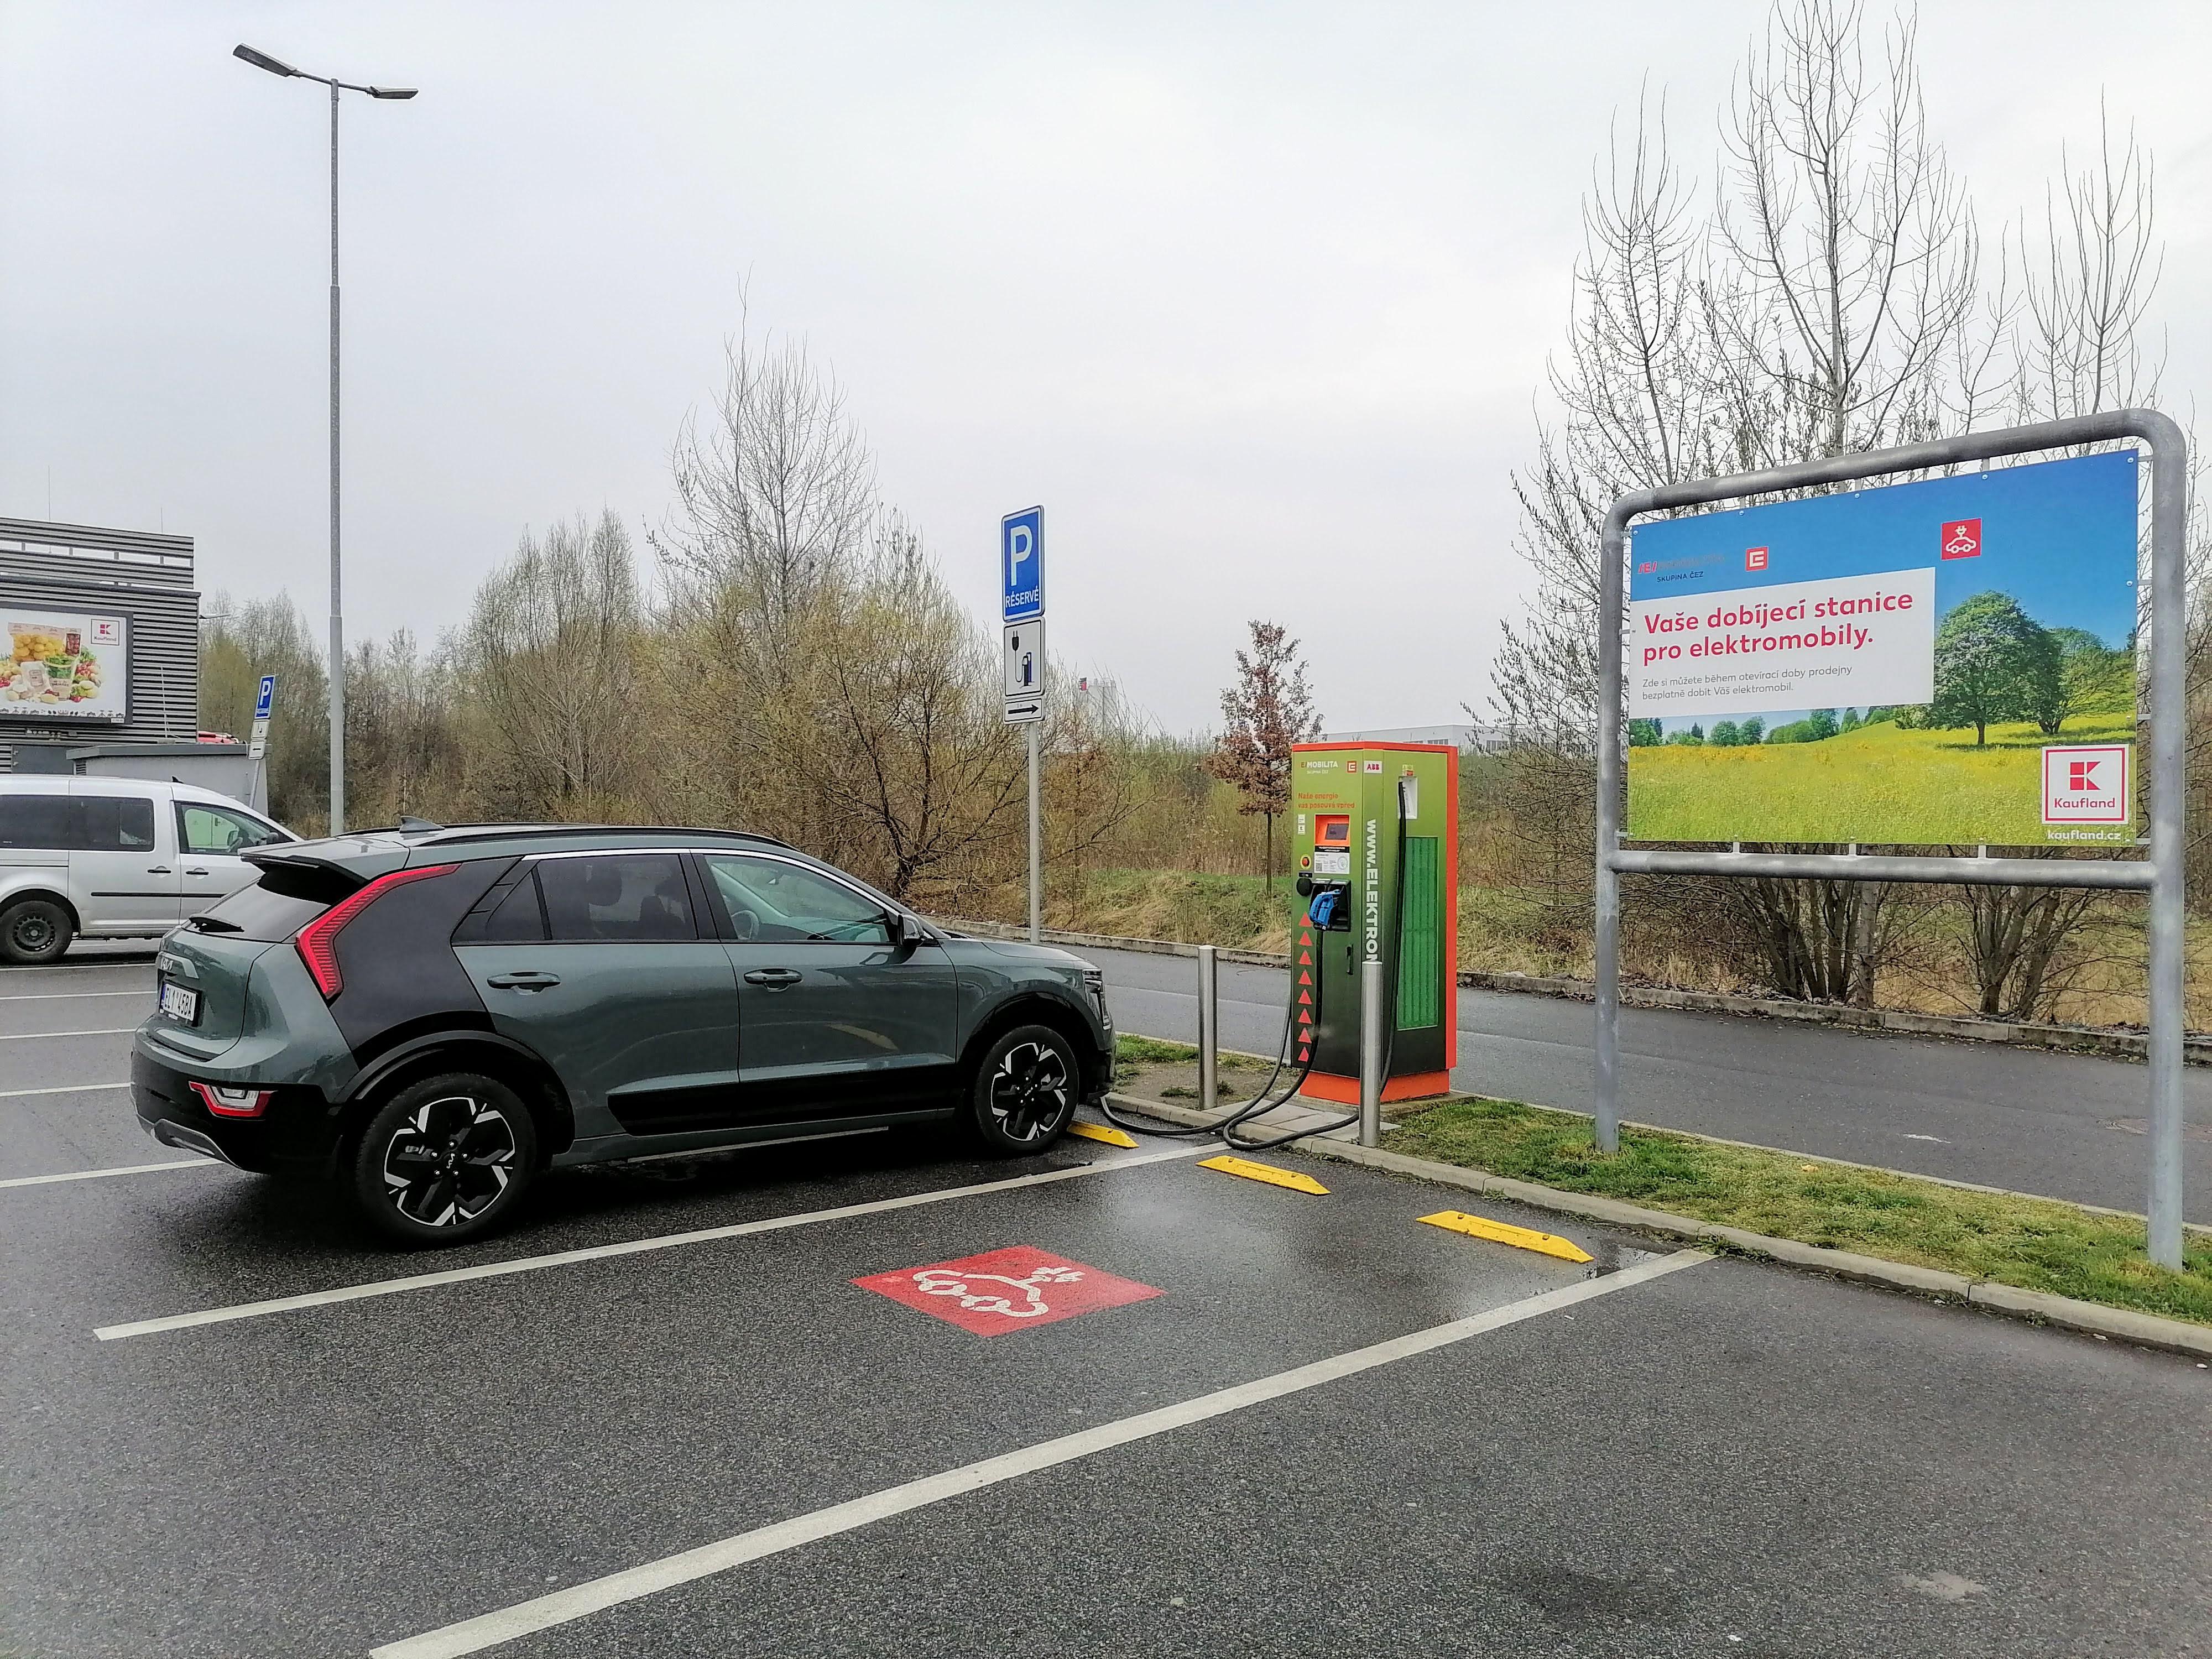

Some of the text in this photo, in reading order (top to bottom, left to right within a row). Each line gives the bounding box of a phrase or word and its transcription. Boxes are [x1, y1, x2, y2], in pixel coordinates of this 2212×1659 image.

[1010, 525, 1032, 586] P
[1657, 572, 1687, 582] SKUPINA
[1005, 585, 1039, 608] RÉSERVÉ
[1644, 591, 1913, 634] Vaše dobíjecí stanice
[1644, 623, 1874, 666] pro elektromobily.
[1642, 679, 1659, 687] Zde
[1670, 676, 1702, 686] můžete
[1705, 674, 1736, 684] během
[1739, 670, 1779, 681] otevírací
[1781, 669, 1806, 679] doby
[1808, 665, 1853, 678] prodejny
[259, 680, 271, 706] P
[1642, 689, 1685, 701] bezplatně
[1714, 686, 1730, 695] Váš
[1733, 682, 1793, 695] elektromobil.
[2054, 797, 2115, 808] Kaufland
[2047, 830, 2121, 840] kaufland.cz
